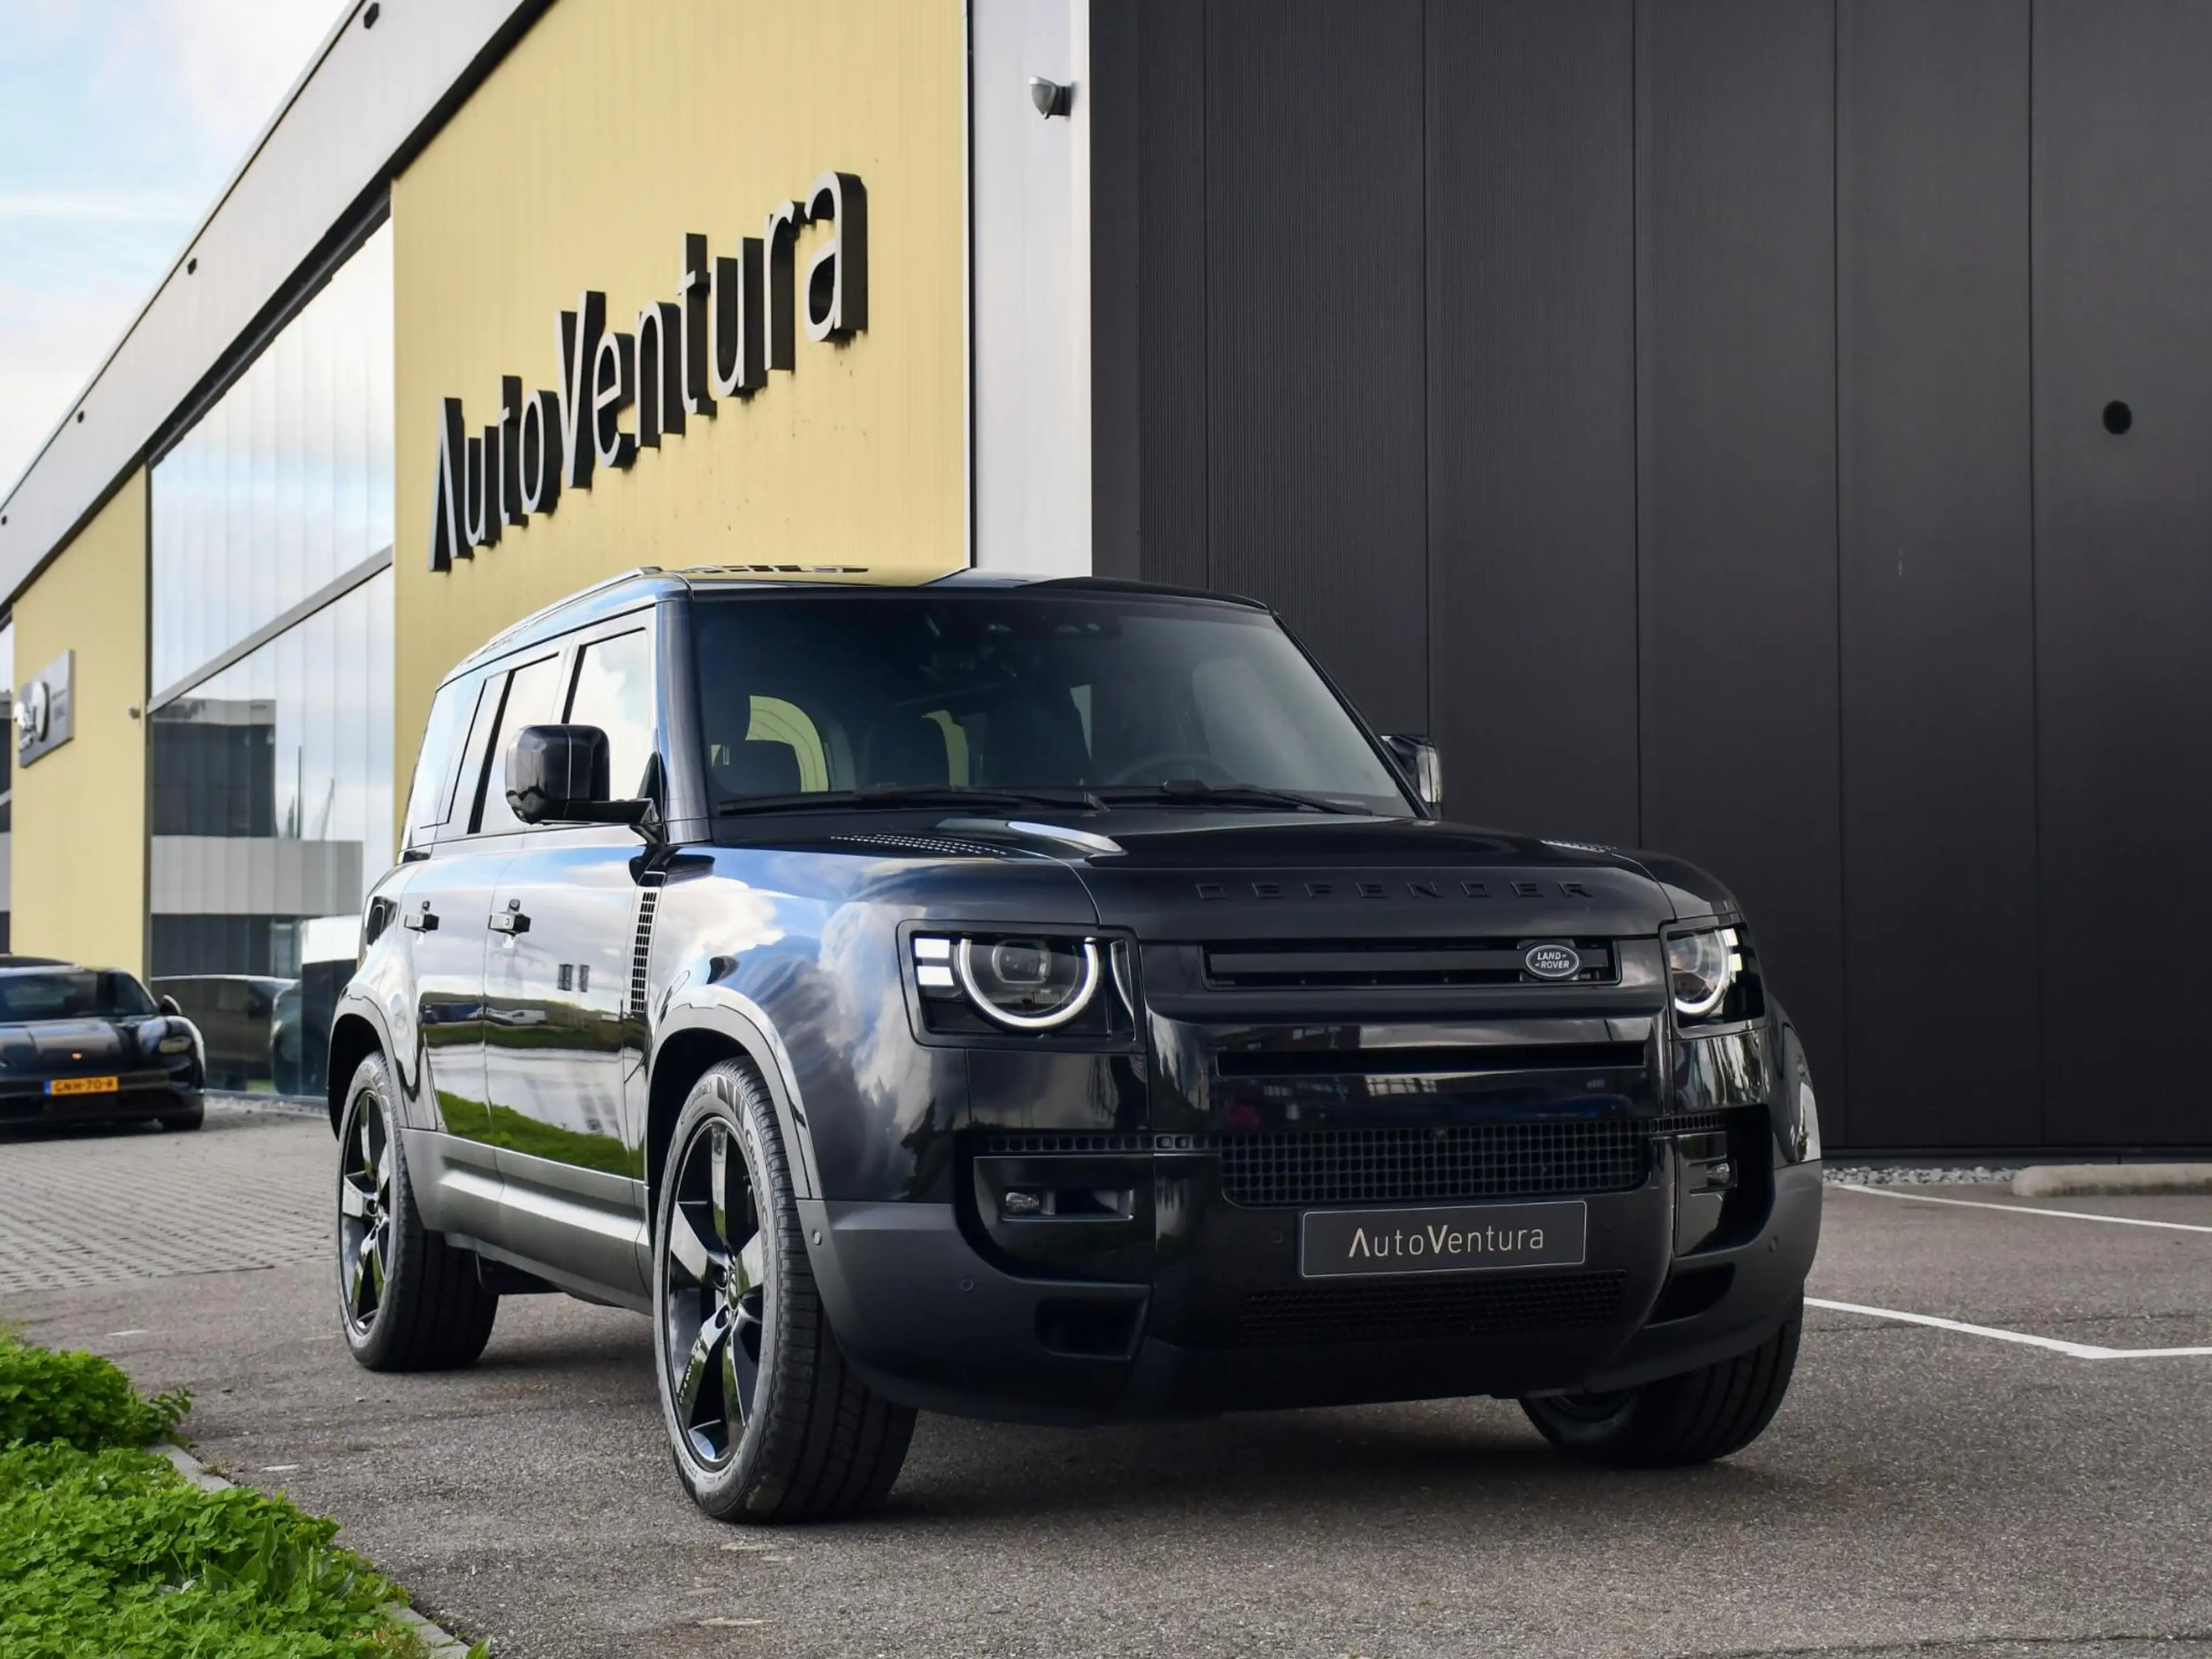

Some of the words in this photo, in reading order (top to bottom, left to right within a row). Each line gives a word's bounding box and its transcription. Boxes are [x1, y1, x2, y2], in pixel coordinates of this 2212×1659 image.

[429, 171, 868, 571] AutoVentura
[1196, 881, 1594, 900] DEFENDER
[1537, 952, 1560, 960] LAND
[1540, 960, 1570, 969] ROVER
[1348, 1224, 1544, 1257] AutoVentura
